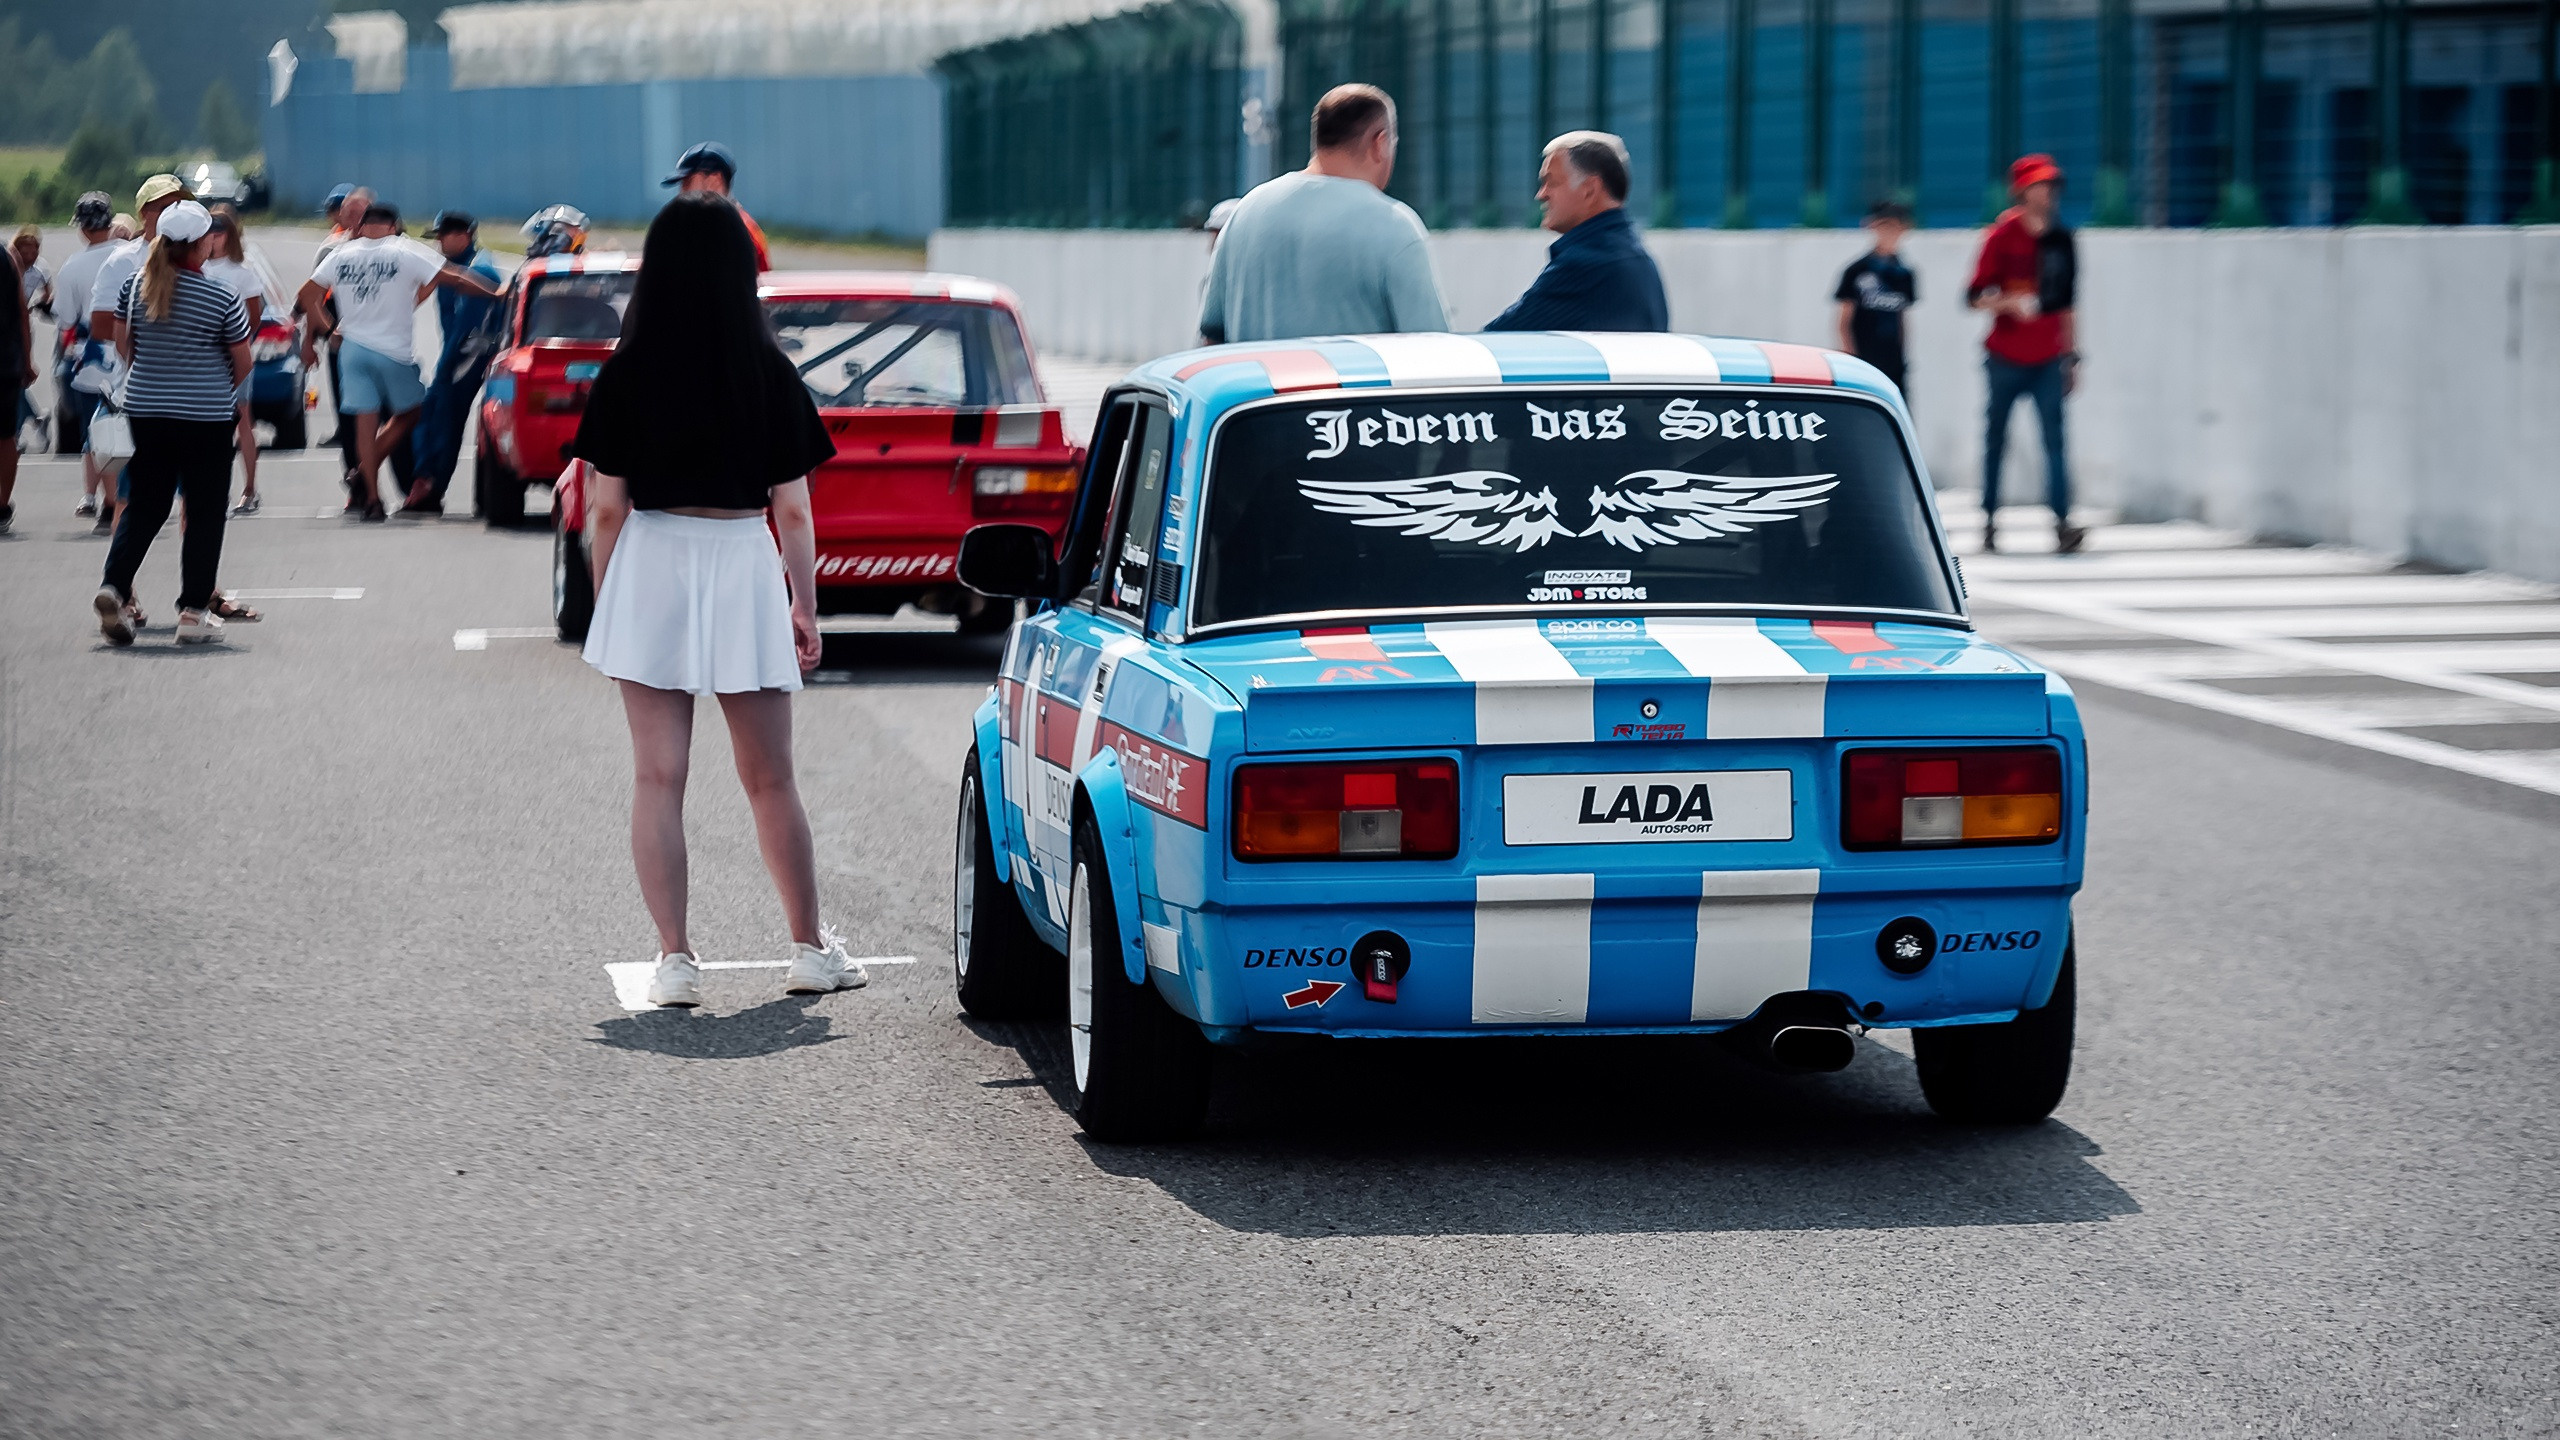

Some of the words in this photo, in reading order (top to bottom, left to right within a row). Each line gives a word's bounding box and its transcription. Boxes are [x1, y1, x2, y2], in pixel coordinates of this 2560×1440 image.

[1306, 408, 1498, 461] Jedem
[1526, 401, 1627, 441] das
[1659, 398, 1828, 442] Seine
[1578, 783, 1714, 825] LADA
[1641, 823, 1714, 835] AUTOSPORT
[1941, 930, 2041, 953] DENSO
[1243, 947, 1348, 969] DENSO
